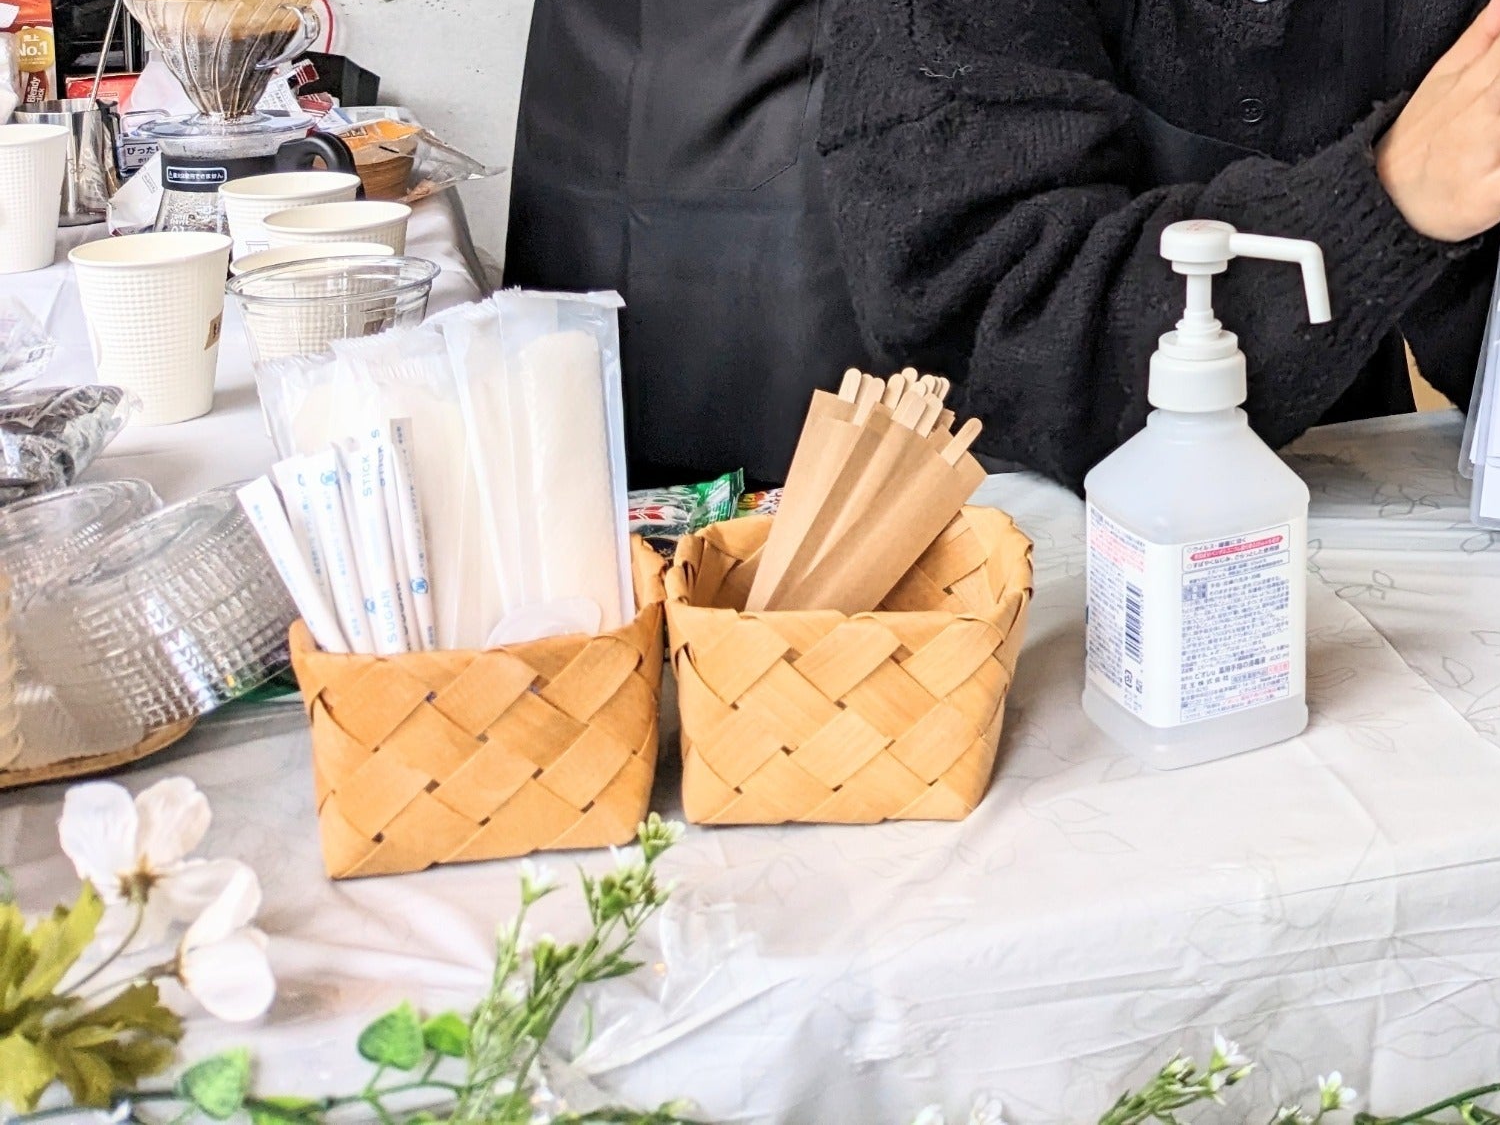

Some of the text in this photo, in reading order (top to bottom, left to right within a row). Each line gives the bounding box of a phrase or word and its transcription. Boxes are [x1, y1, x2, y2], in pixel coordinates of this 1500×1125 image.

[26, 76, 41, 103] Blendy
[361, 454, 373, 498] STICK
[381, 589, 398, 644] SUGAR
